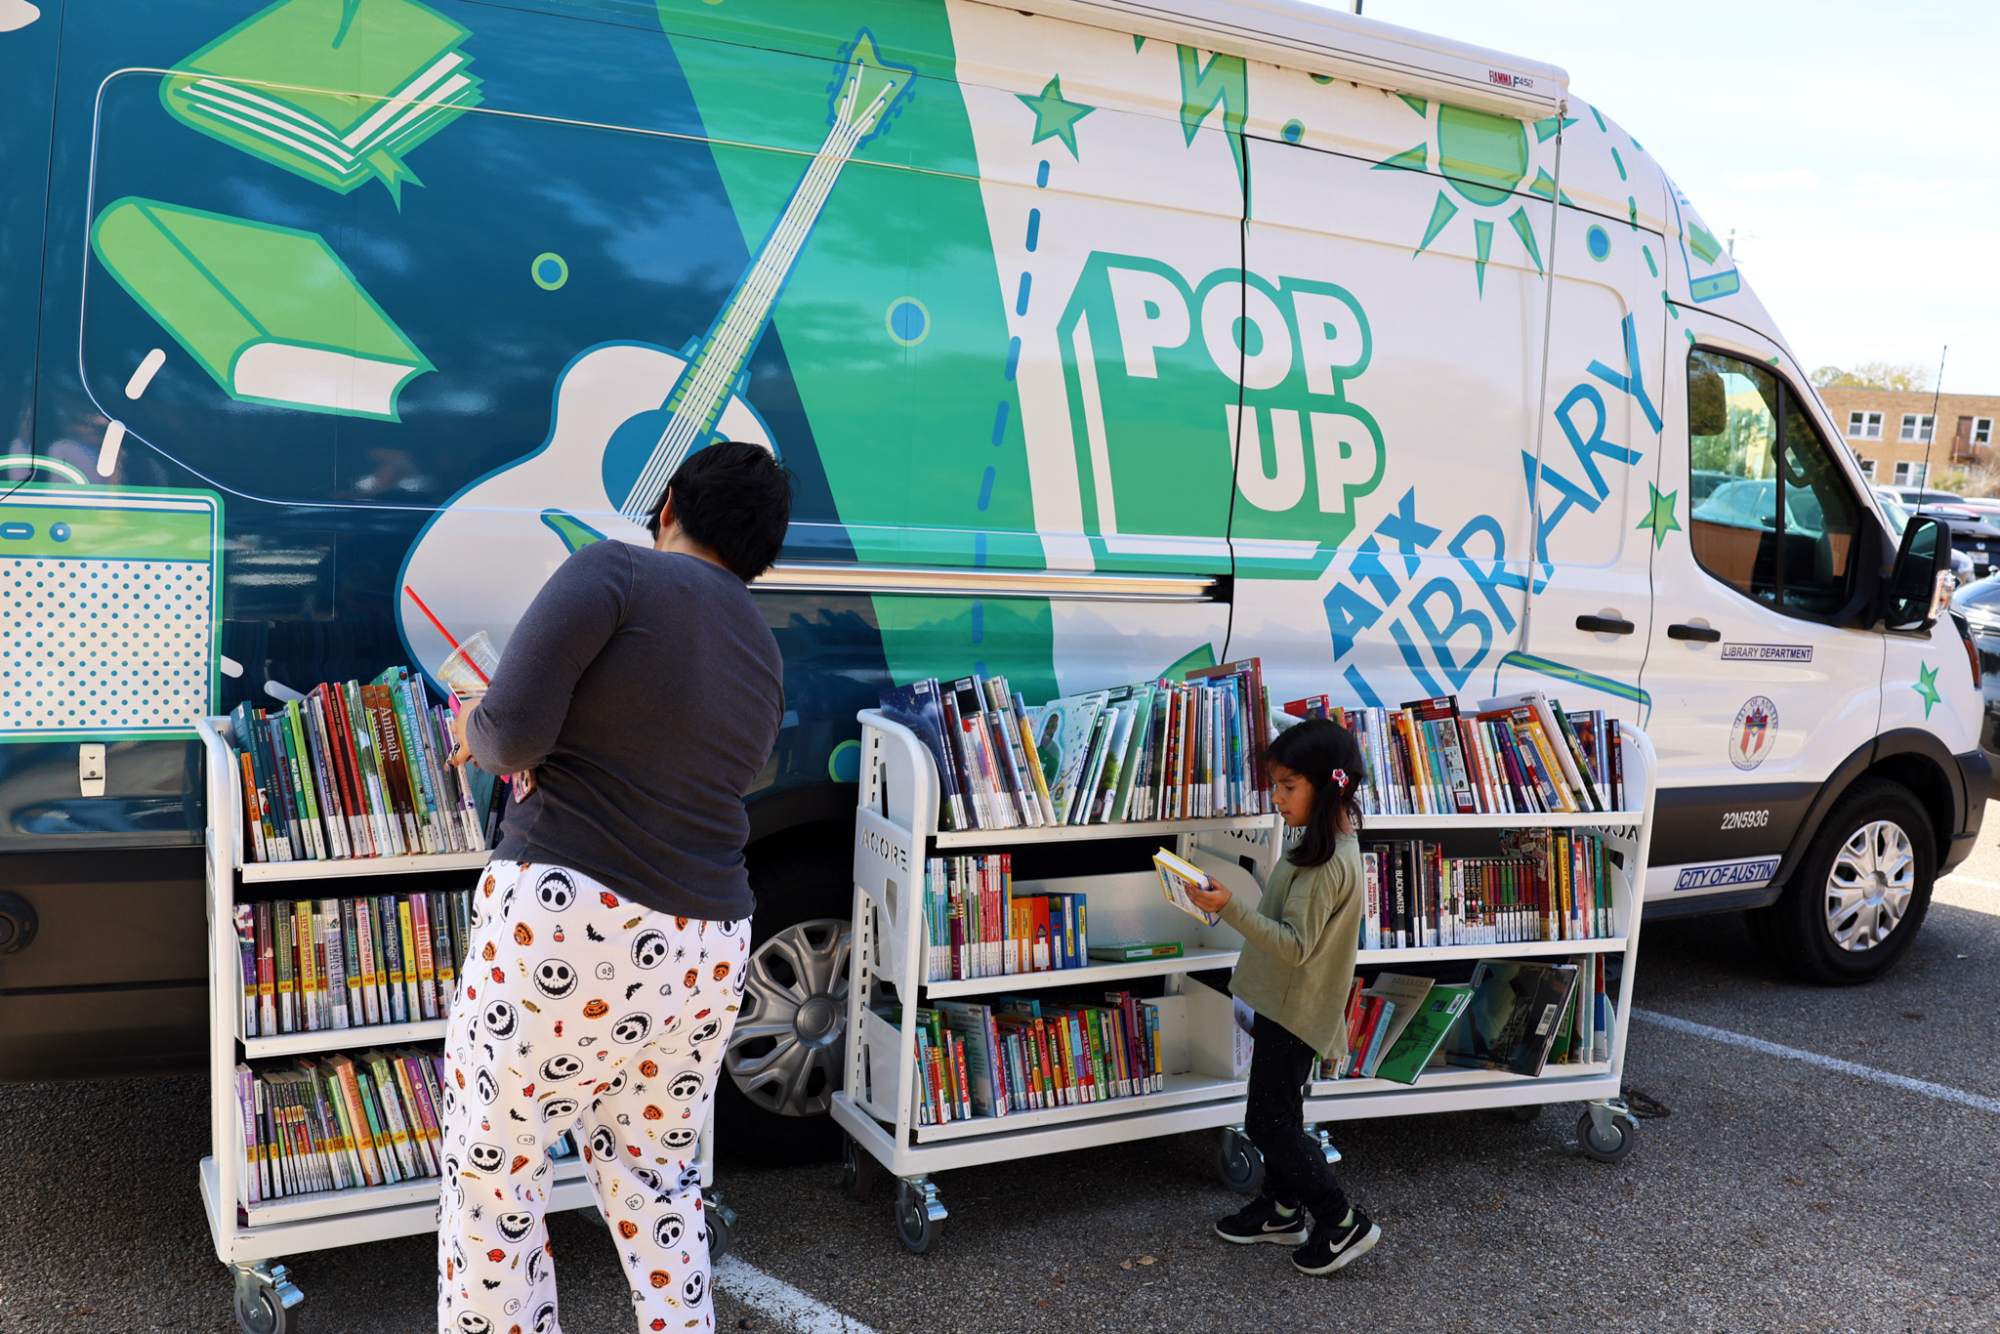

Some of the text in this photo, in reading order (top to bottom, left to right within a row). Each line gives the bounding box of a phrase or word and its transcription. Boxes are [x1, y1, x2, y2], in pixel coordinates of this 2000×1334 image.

[1489, 70, 1512, 86] FIAMMA
[1107, 266, 1363, 397] POP
[1225, 403, 1378, 514] UP
[1322, 485, 1442, 663] ATX
[1724, 646, 1812, 660] LIBRARY DEPARTMENT
[380, 707, 400, 762] Animals
[402, 714, 416, 761] MIGRATION
[402, 682, 433, 798] NATURE'S FASCINATING FRIENDSHIPS
[326, 792, 334, 816] UNIVERSE
[1721, 810, 1770, 830] 22N593G
[860, 828, 908, 872] ACORE
[1678, 860, 1777, 888] CITY OF AUSTIN
[1395, 870, 1405, 914] BLACKWATER
[360, 912, 368, 938] CRUZITA
[300, 914, 314, 978] LILY XIAO SPEAKS
[348, 929, 358, 958] ZOMBIE
[416, 924, 432, 962] LION OF
[328, 938, 346, 990] STRAYS LIKE
[1090, 1024, 1100, 1055] COLORS
[346, 1076, 357, 1092] CECE
[962, 1089, 967, 1098] ME
[350, 1095, 362, 1111] RIOS
